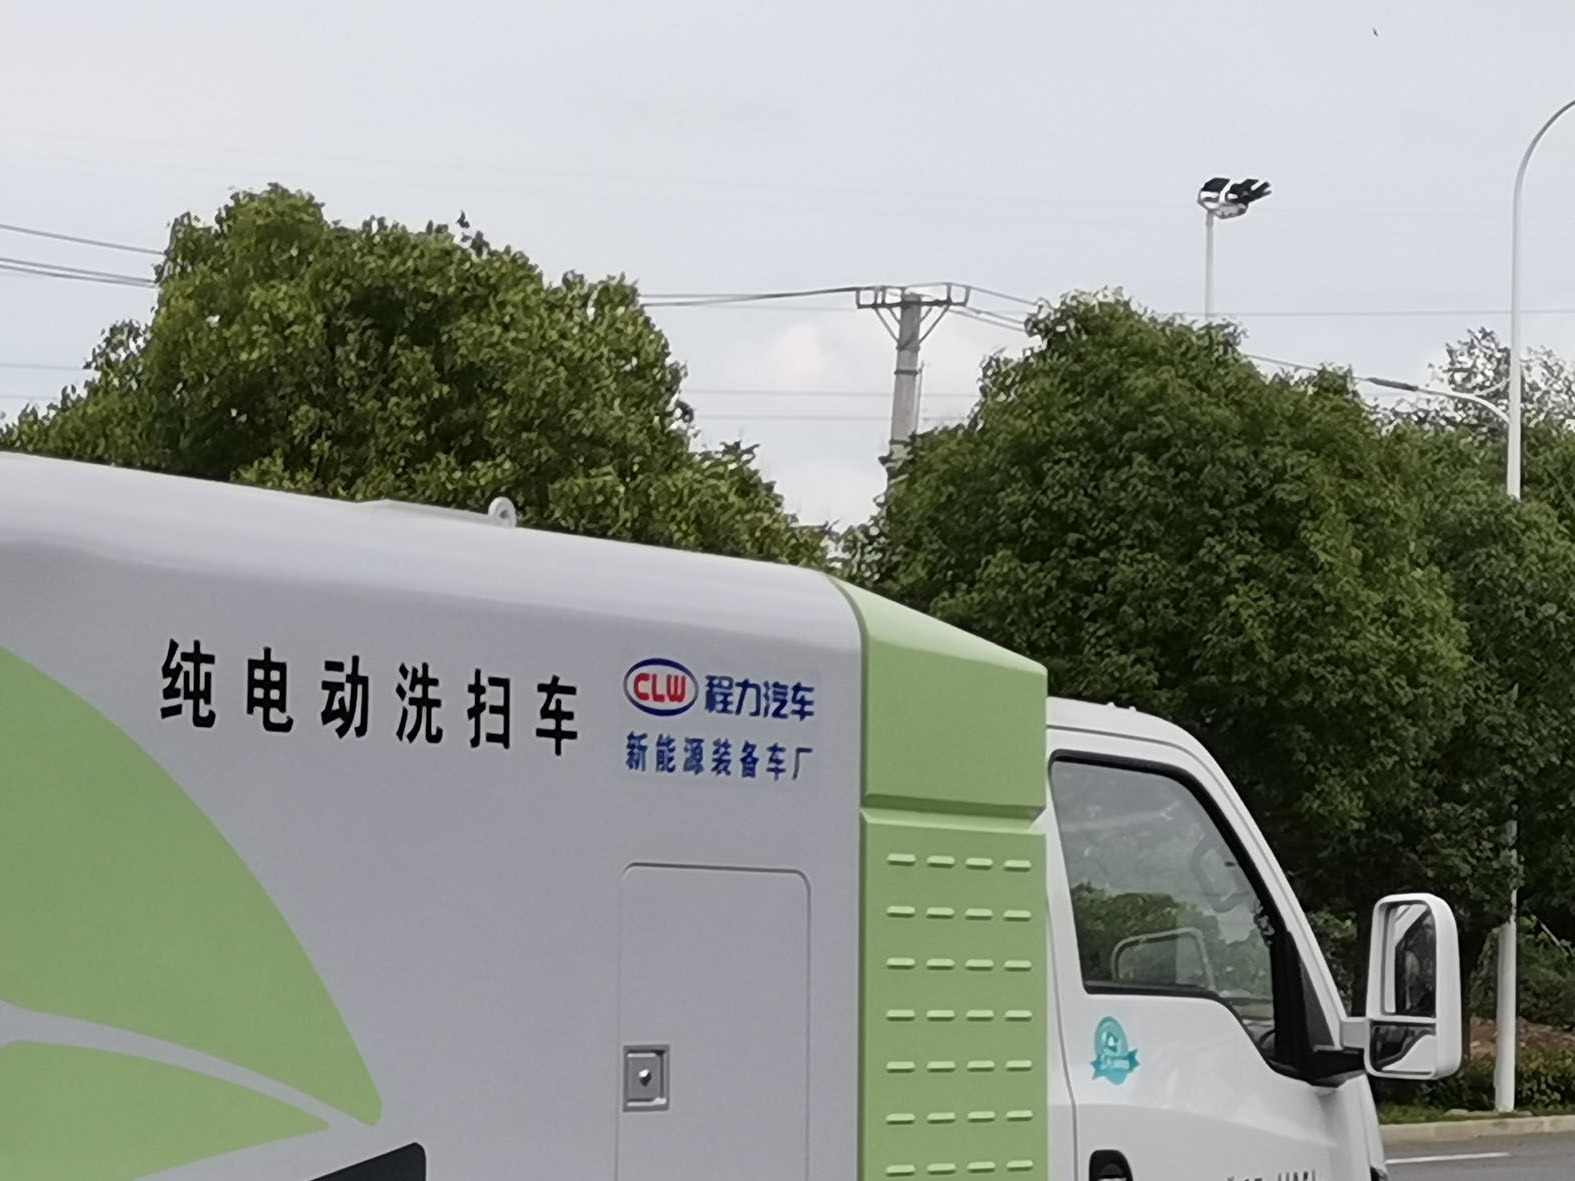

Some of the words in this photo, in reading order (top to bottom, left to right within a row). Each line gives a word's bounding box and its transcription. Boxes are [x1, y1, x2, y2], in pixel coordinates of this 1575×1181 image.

[160, 638, 579, 757] 纯电动洗扫车
[633, 672, 686, 703] CLW
[705, 674, 815, 721] 程力汽车
[625, 731, 813, 781] 新能源装备车厂
